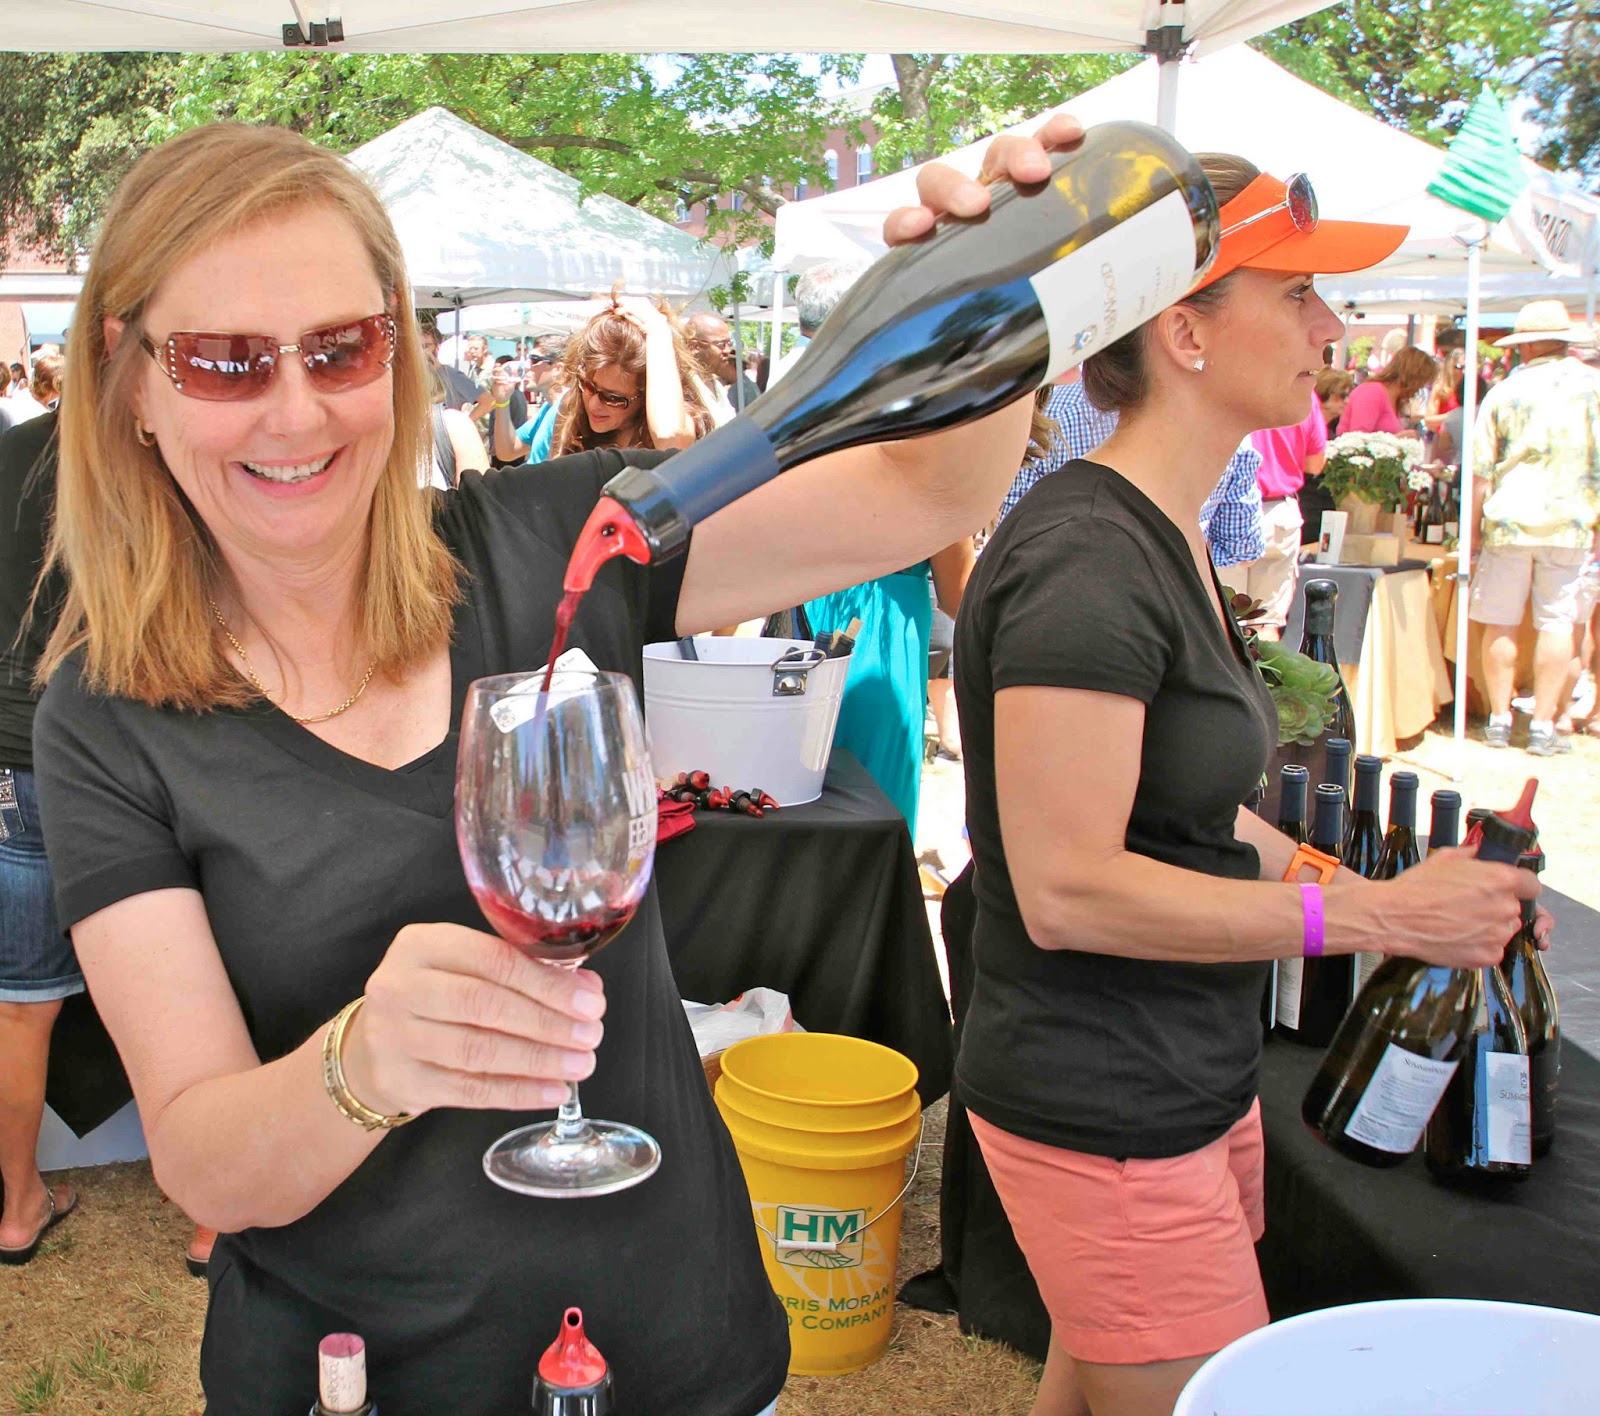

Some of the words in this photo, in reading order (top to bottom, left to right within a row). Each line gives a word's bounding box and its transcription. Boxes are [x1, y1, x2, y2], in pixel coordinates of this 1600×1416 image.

[782, 1210, 859, 1243] HM
[829, 1284, 889, 1312] MORAN
[802, 1304, 886, 1330] COMPANY
